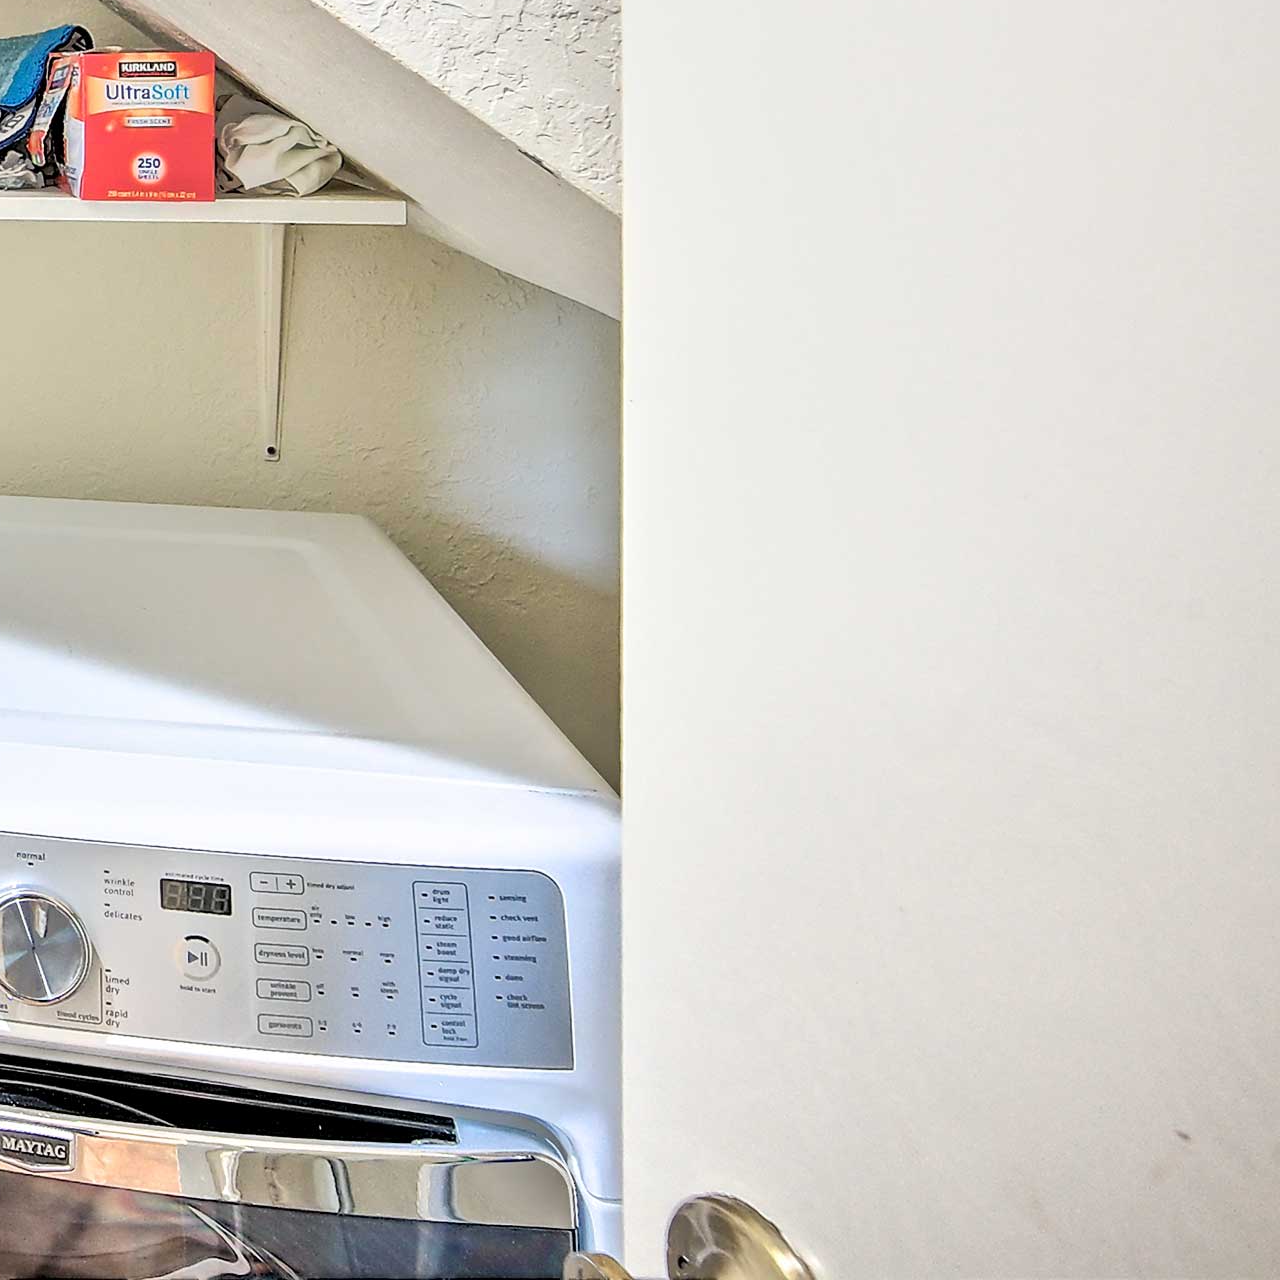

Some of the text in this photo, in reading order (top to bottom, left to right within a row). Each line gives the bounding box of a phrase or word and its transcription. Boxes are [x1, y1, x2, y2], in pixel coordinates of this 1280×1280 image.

[121, 63, 175, 72] KIRKLAND
[105, 84, 189, 100] UltraSoft
[137, 158, 160, 169] 250
[16, 851, 46, 861] normal
[104, 878, 135, 887] wrinkle
[104, 887, 135, 897] control
[432, 896, 449, 904] light
[499, 895, 527, 903] sensing
[104, 910, 142, 921] delicates
[257, 913, 301, 924] temperature
[500, 914, 521, 922] check
[258, 949, 305, 960] dryness level
[504, 955, 537, 963] steaming
[105, 975, 130, 985] timed
[105, 985, 120, 996] dry
[440, 993, 458, 1001] cycle
[105, 1009, 128, 1019] rapid
[105, 1019, 120, 1029] dry
[268, 1021, 302, 1031] garments
[441, 1027, 456, 1035] lock
[1, 1135, 67, 1159] MAYTAG
